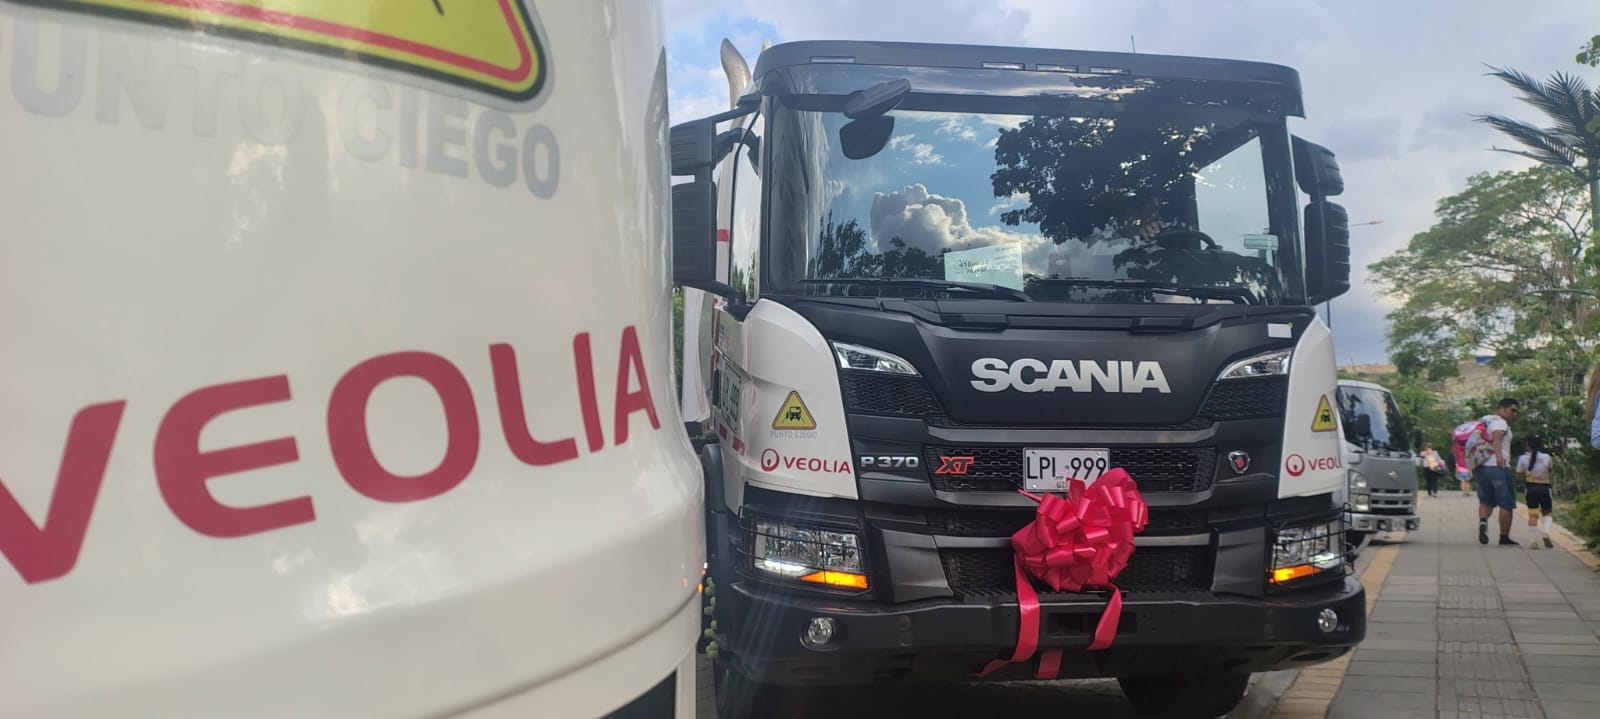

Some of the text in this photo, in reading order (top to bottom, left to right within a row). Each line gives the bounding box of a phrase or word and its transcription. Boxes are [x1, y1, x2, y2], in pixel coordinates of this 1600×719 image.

[339, 78, 561, 200] CIEGO
[970, 357, 1171, 394] SCANIA
[770, 430, 817, 439] PUNTO CIEGO
[0, 325, 662, 585] VEOLIA
[783, 456, 851, 474] VEOLIA
[861, 456, 919, 468] P 370
[935, 456, 976, 475] XT
[1070, 457, 1107, 480] 999
